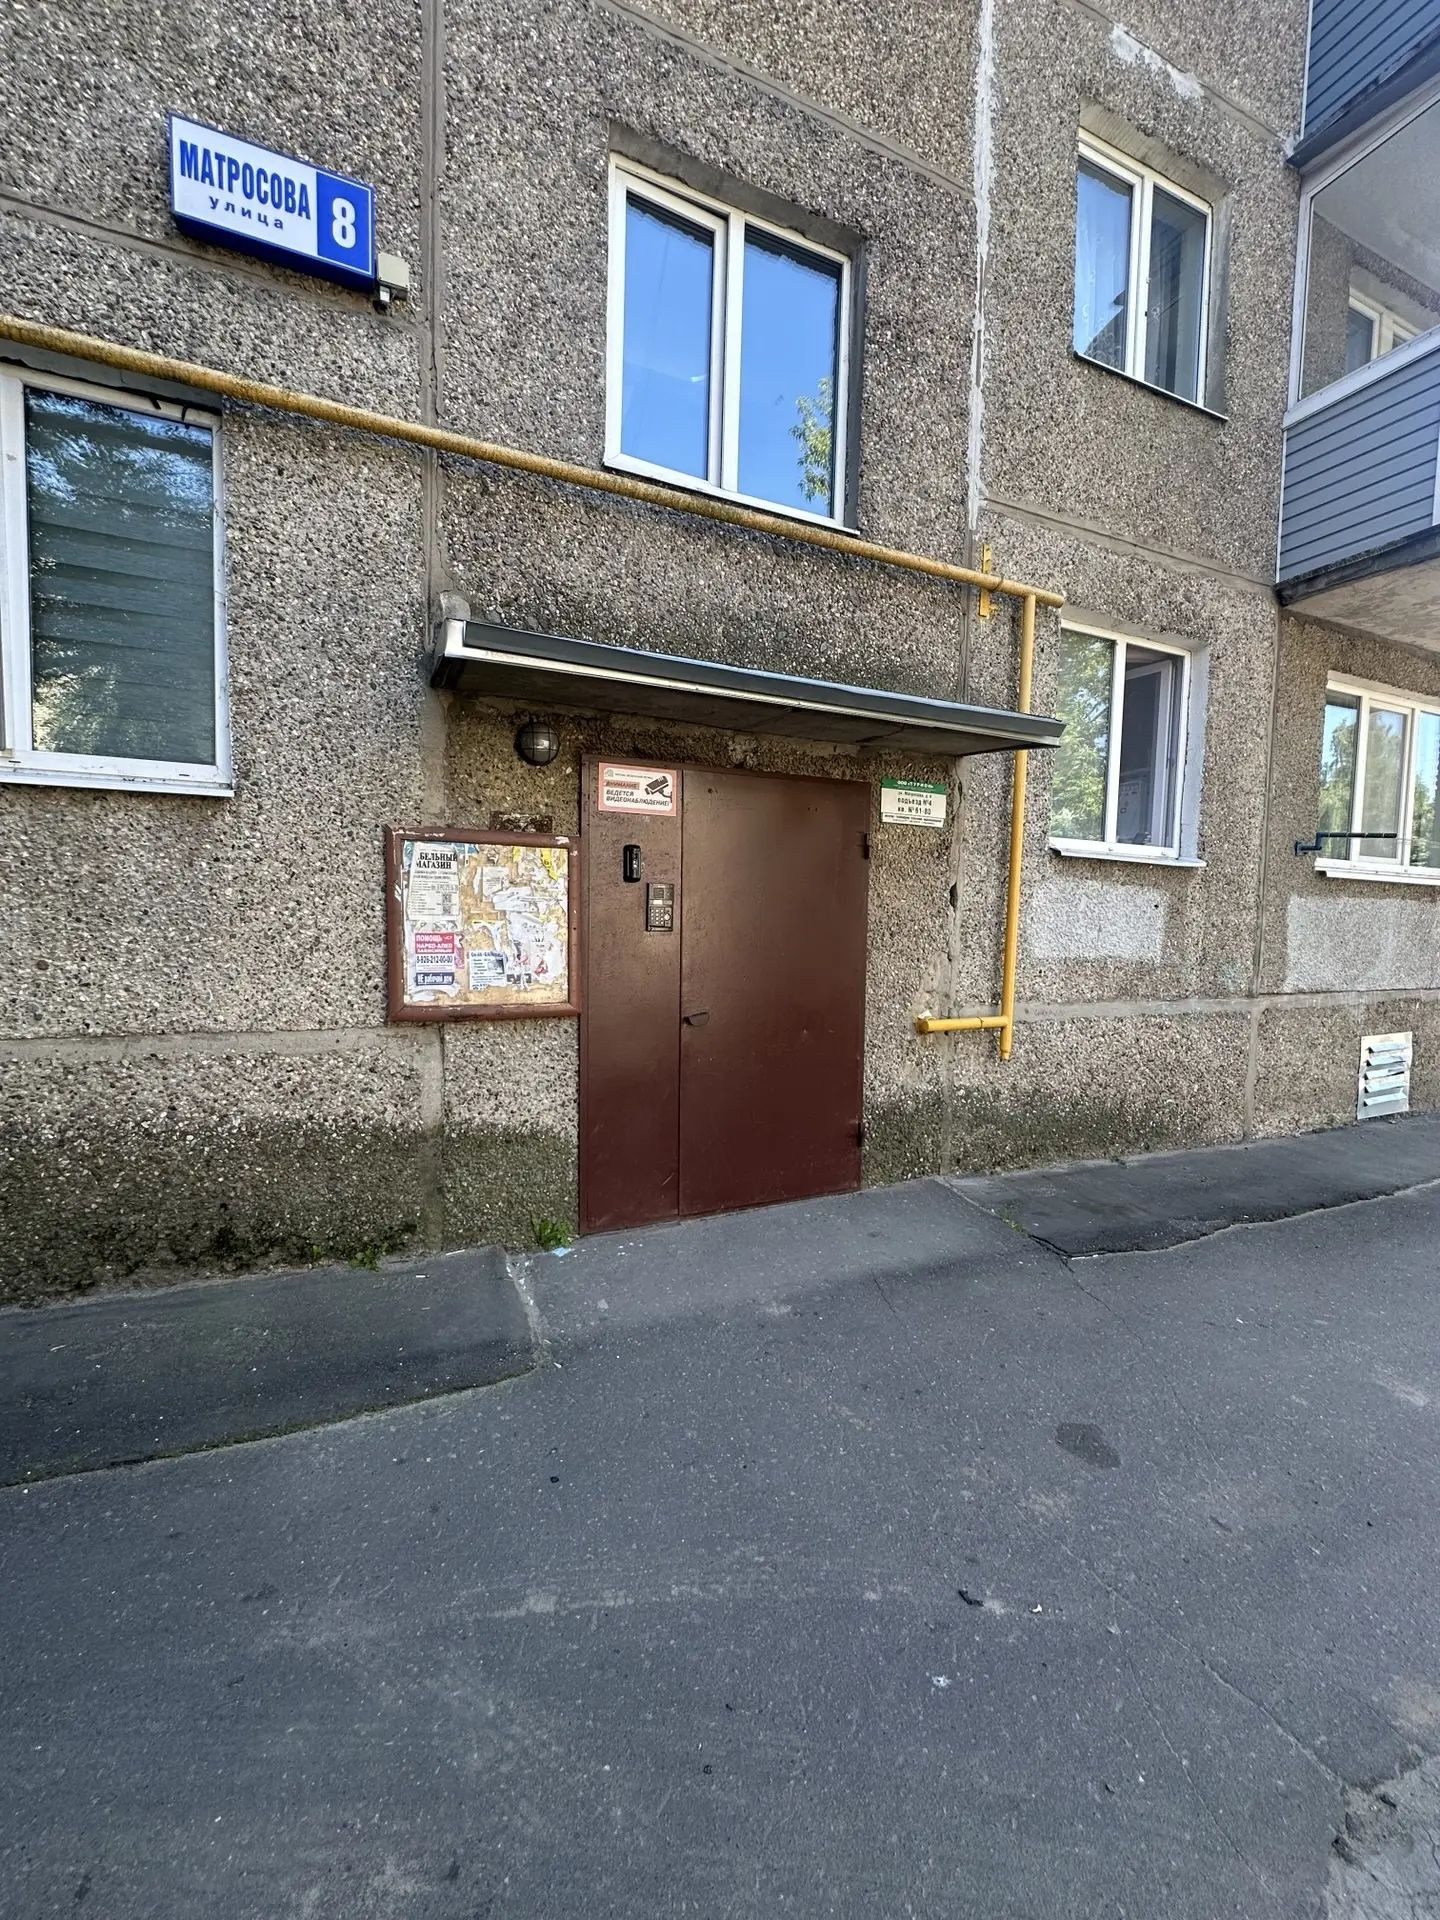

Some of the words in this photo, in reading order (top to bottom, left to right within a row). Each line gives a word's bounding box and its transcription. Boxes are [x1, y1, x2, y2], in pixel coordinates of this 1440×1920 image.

[179, 140, 311, 220] МАТРОСОВА
[332, 197, 356, 249] 8
[209, 196, 284, 230] улица
[606, 789, 634, 797] ВЕДЕТСЯ
[418, 851, 457, 861] БЕЛЬНЫЙ
